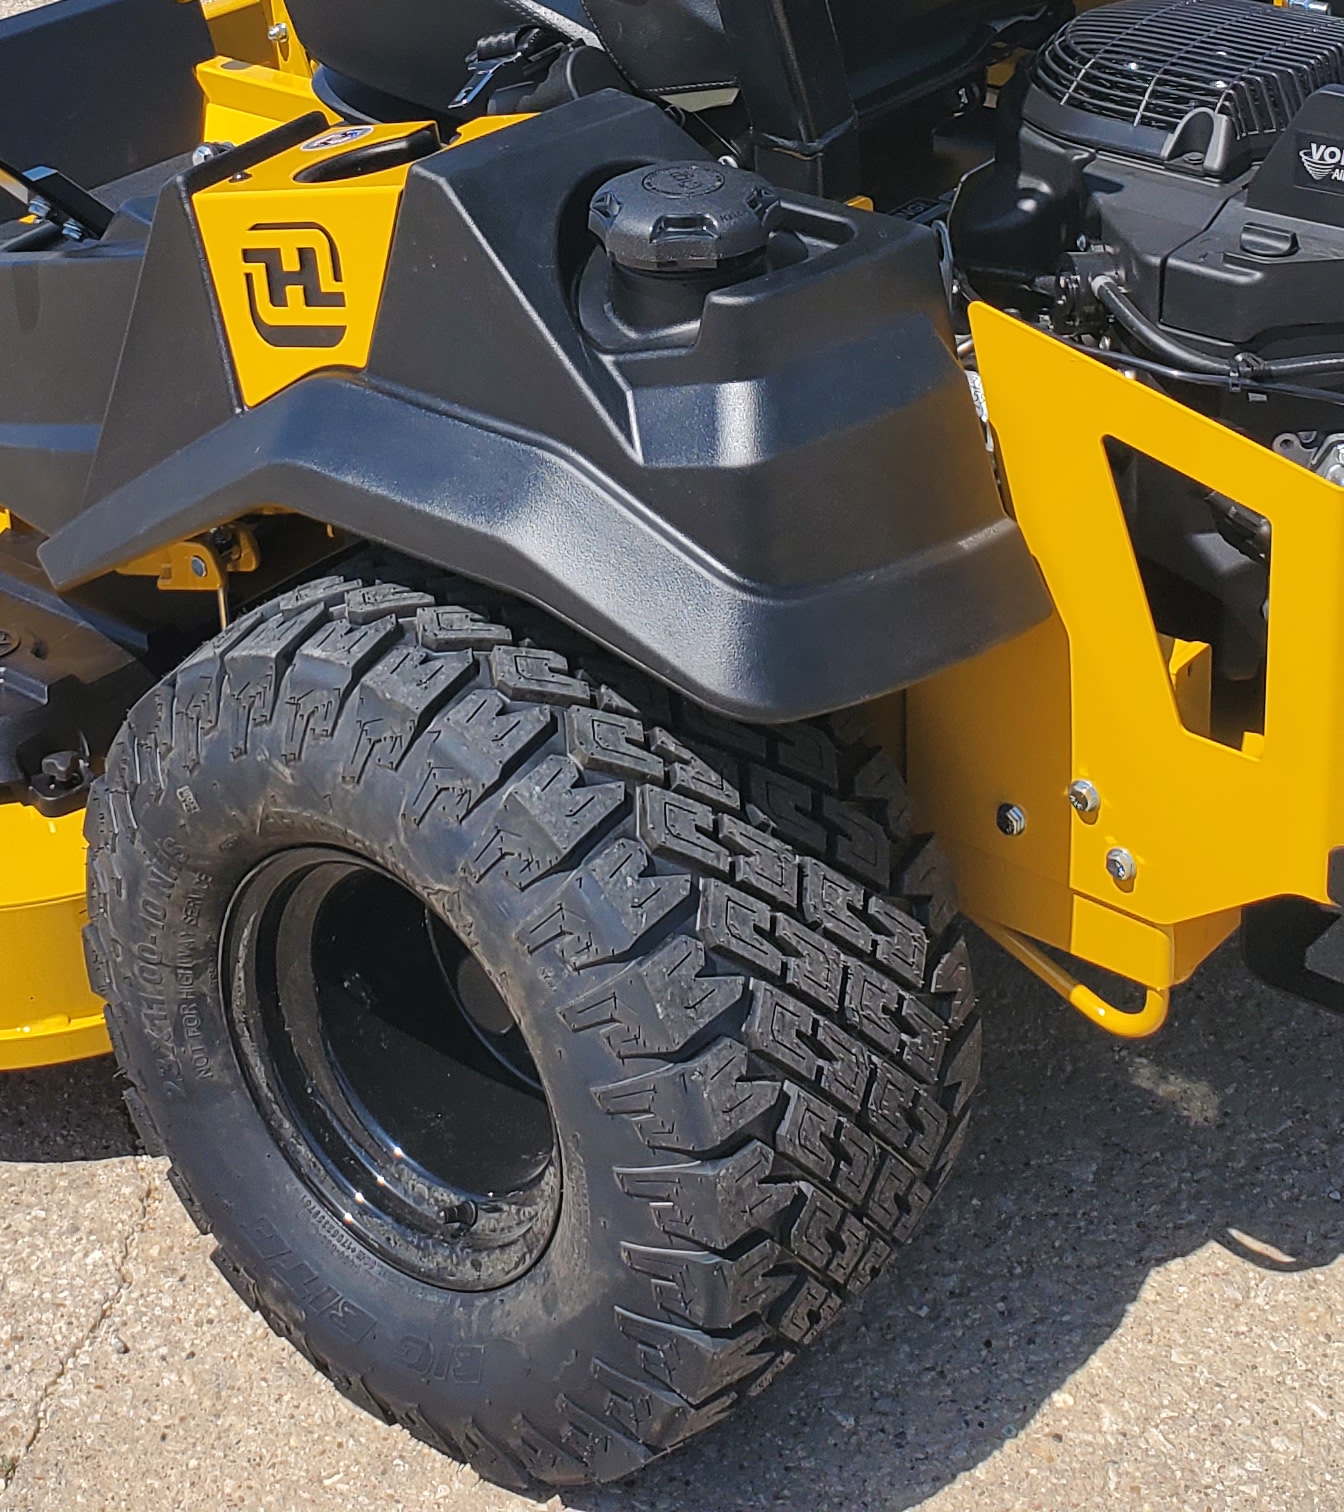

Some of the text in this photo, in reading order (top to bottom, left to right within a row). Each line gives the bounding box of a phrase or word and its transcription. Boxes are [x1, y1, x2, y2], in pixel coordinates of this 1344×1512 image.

[180, 1002, 202, 1038] FOR
[192, 1043, 214, 1081] NOT
[241, 1216, 378, 1344] BITE
[395, 1336, 485, 1384] BIG
